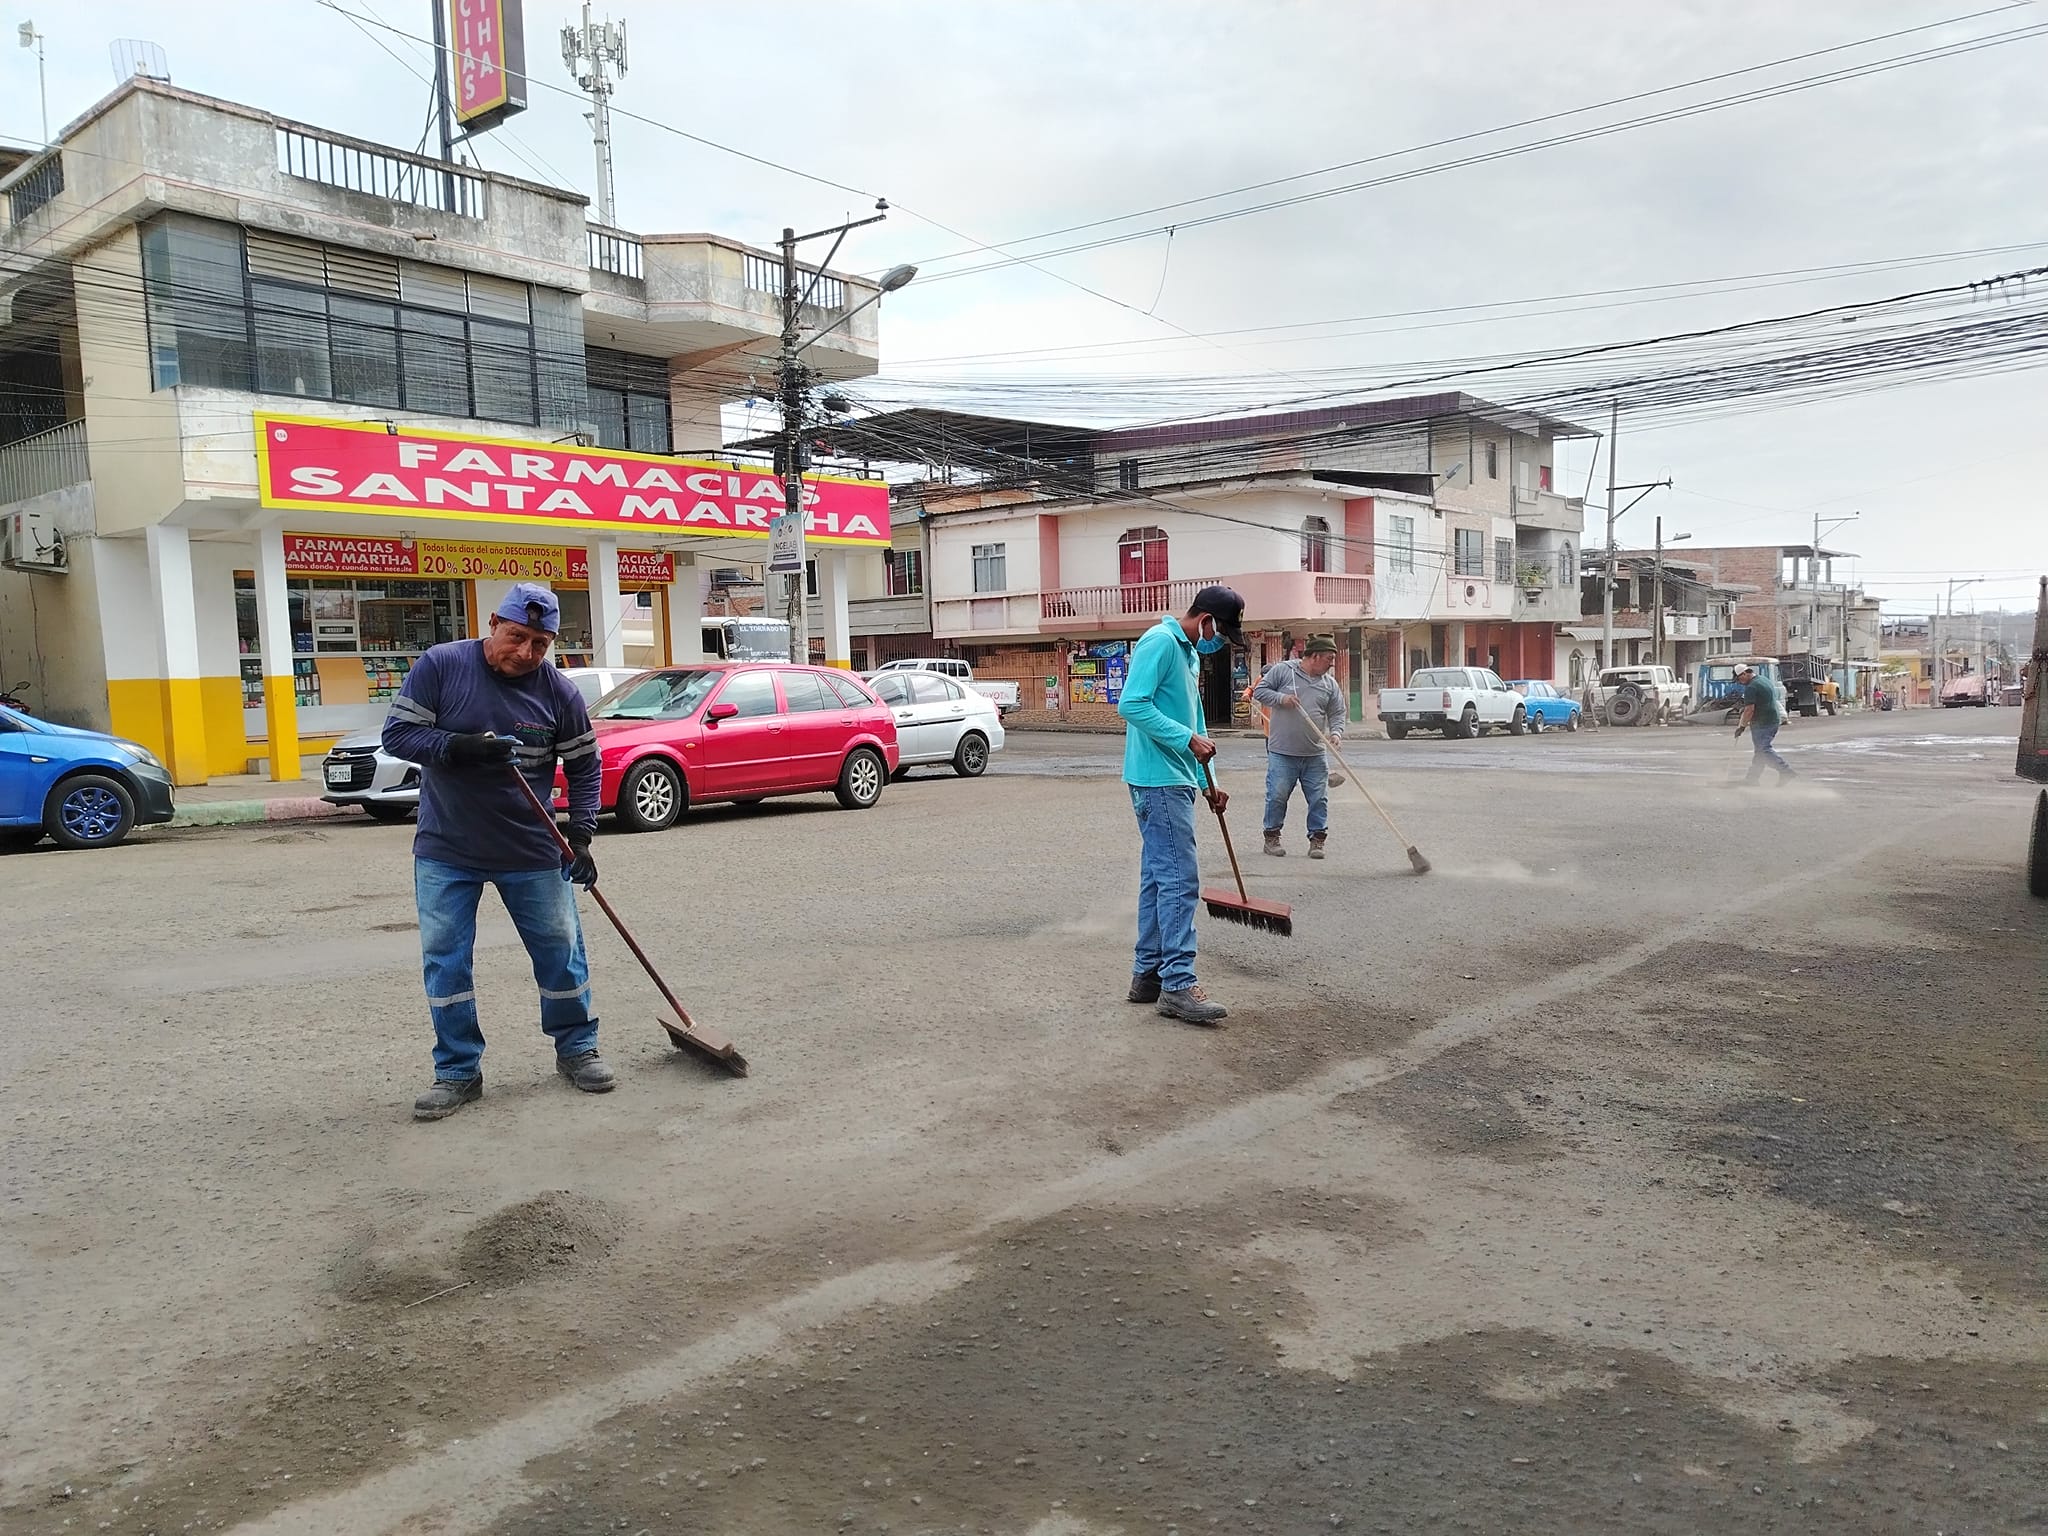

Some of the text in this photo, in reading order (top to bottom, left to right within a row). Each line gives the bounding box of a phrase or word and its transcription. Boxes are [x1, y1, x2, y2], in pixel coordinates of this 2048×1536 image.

[398, 440, 820, 505] FARMACIAS
[289, 466, 594, 515] SANTA
[295, 538, 394, 553] FARMACIAS
[422, 542, 445, 552] Todos
[446, 544, 458, 553] los
[476, 545, 488, 554] del
[489, 546, 504, 555] año
[505, 546, 550, 557] DESCUENTOS
[551, 548, 563, 557] del
[310, 562, 334, 571] donde
[341, 563, 368, 571] cuando
[341, 553, 412, 566] MARTHA
[423, 555, 458, 575] 20%
[461, 557, 495, 576] 30%
[497, 558, 530, 577] 40%
[533, 560, 563, 578] 50%
[619, 566, 670, 575] MARTHA
